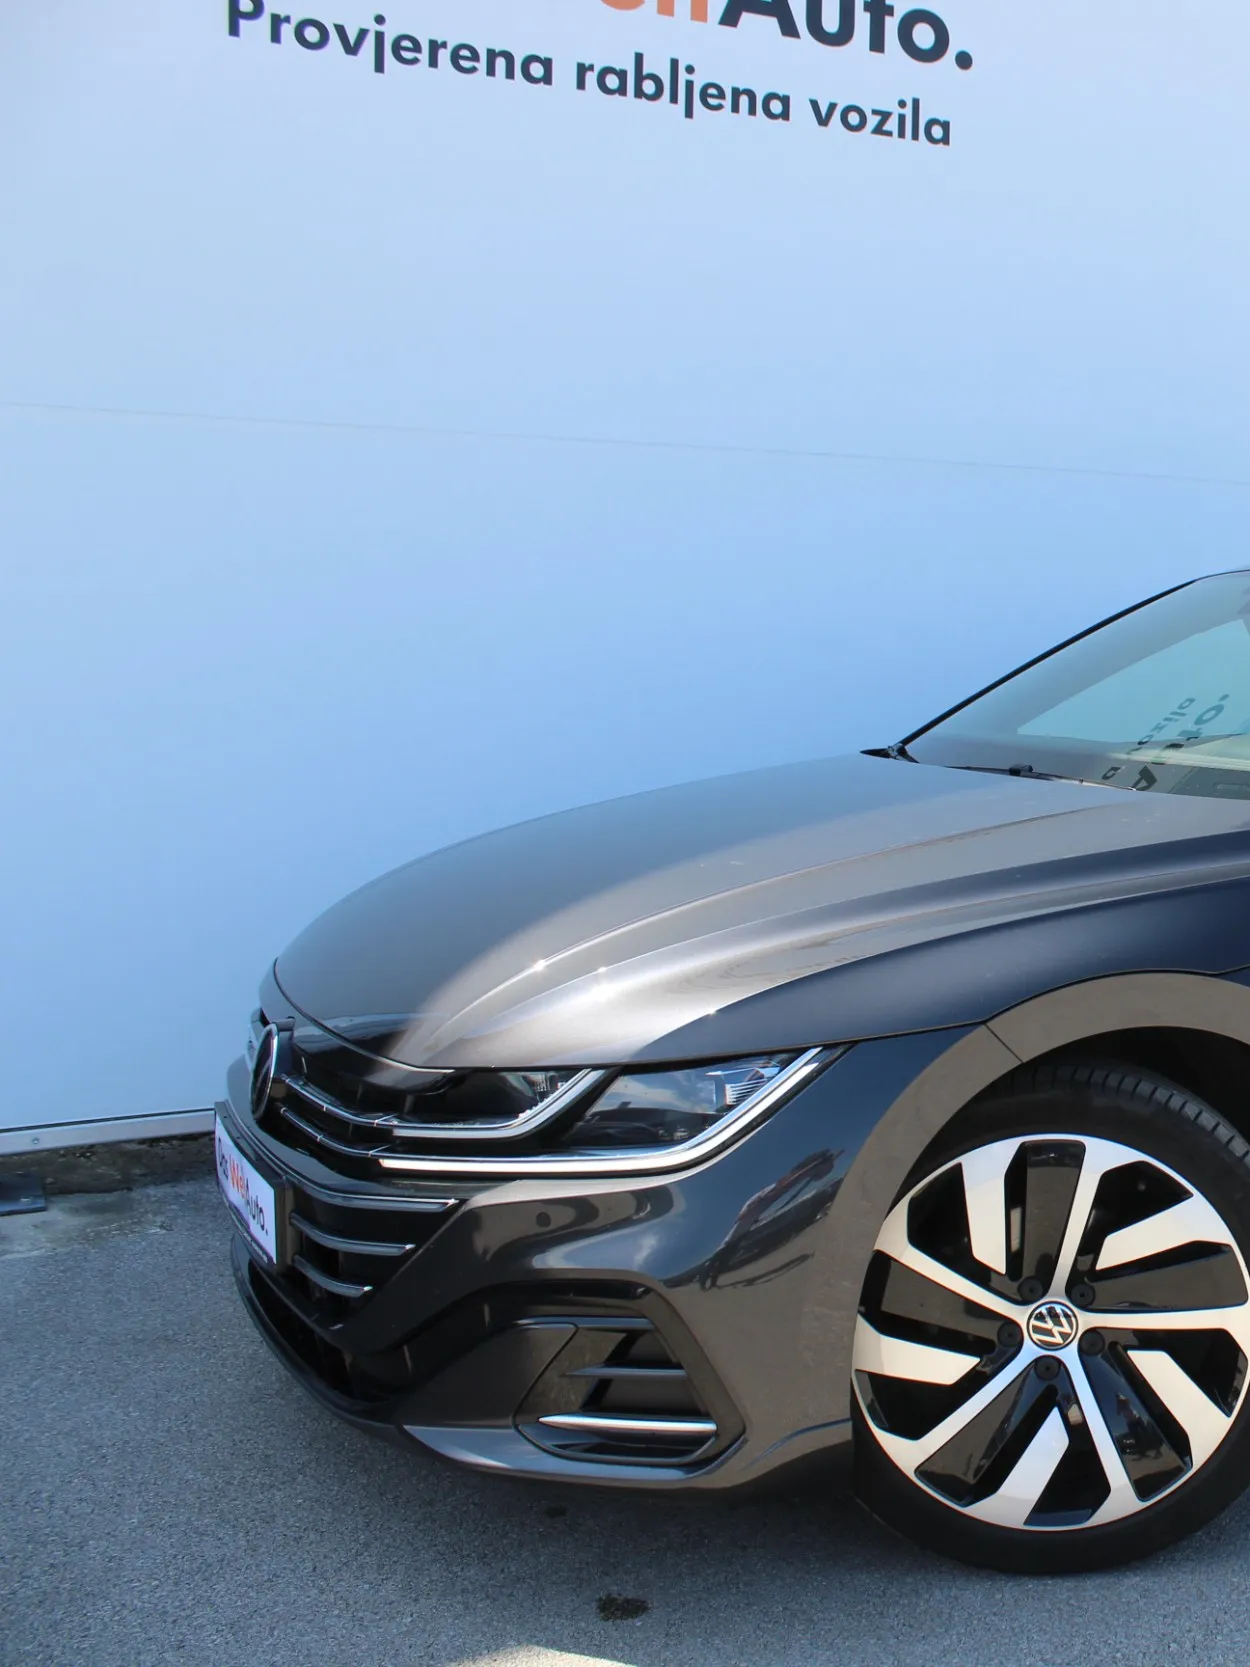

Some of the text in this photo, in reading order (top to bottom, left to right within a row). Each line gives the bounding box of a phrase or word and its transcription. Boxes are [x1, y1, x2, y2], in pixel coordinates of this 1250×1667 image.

[228, 0, 951, 147] Provjerena rabljena vozila
